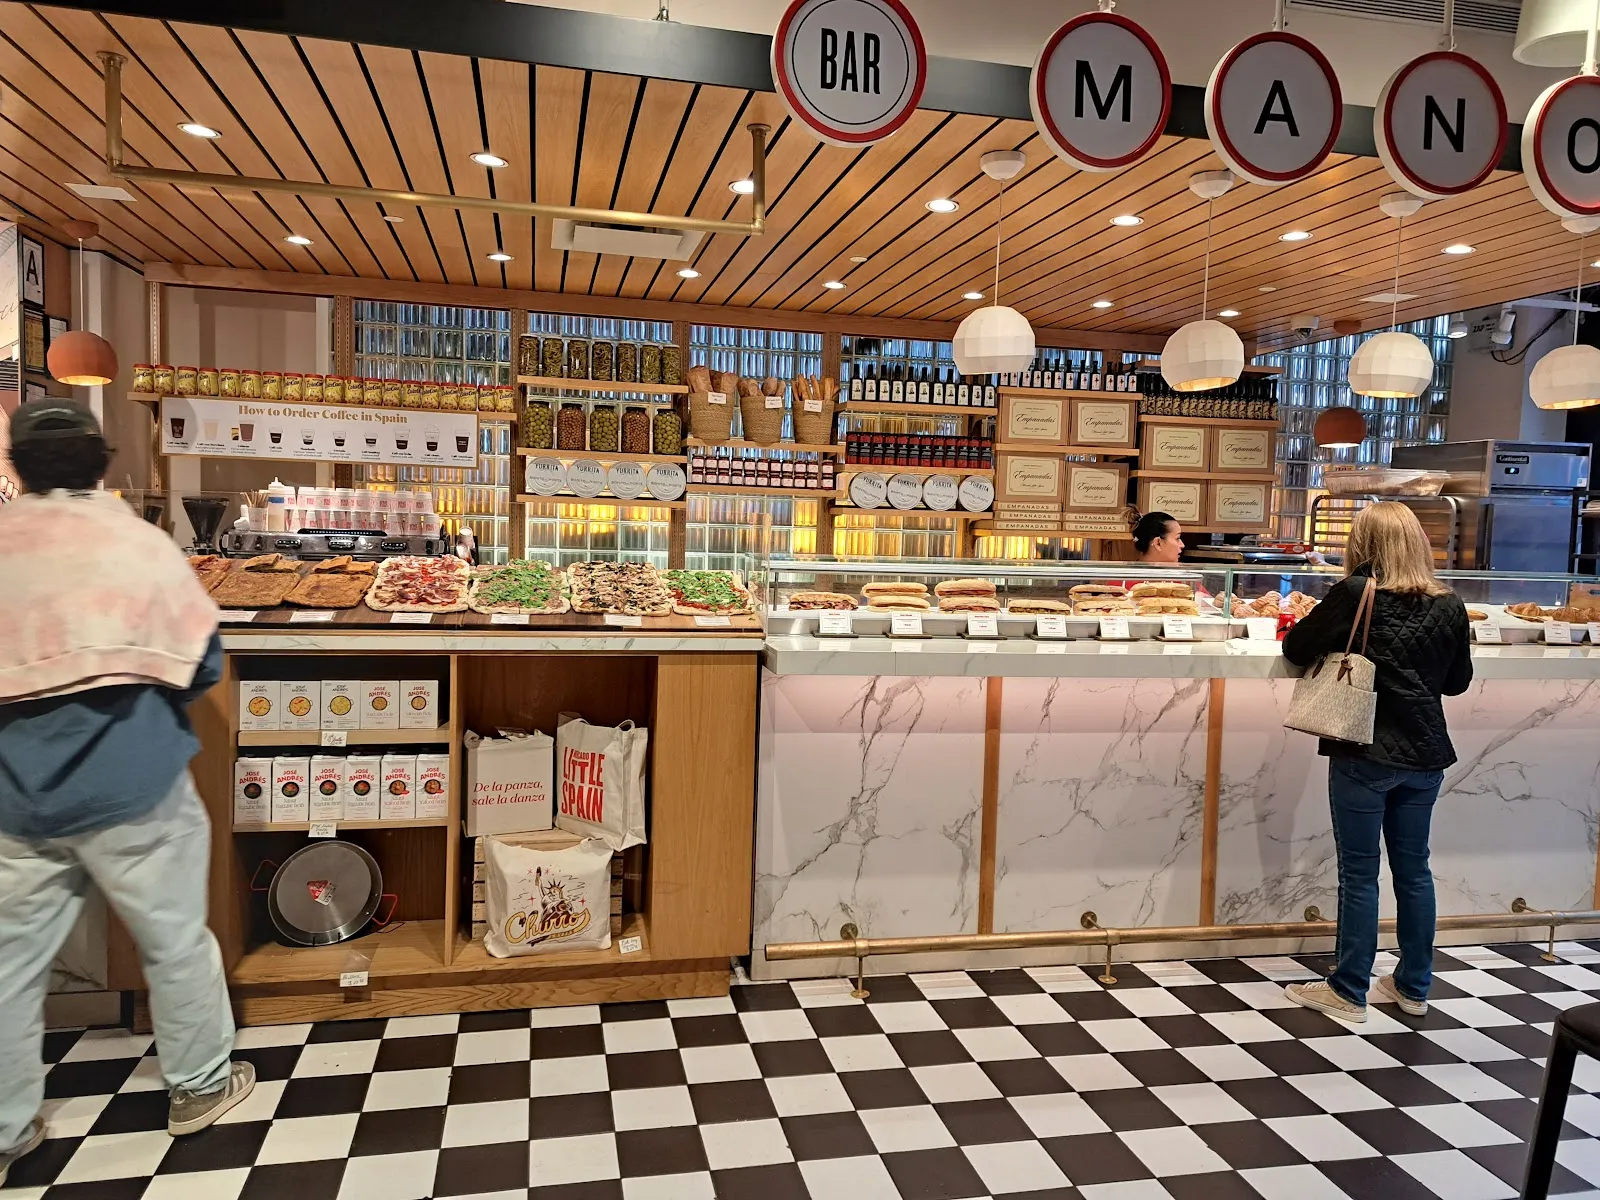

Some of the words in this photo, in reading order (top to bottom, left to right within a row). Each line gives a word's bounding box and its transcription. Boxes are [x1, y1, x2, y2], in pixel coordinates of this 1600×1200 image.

[820, 27, 881, 95] BAR
[1074, 60, 1133, 123] M
[1253, 79, 1300, 137] A
[1422, 95, 1466, 153] N
[1567, 117, 1600, 174] O
[238, 404, 266, 416] How
[268, 405, 281, 417] to
[282, 406, 320, 419] Order
[322, 409, 359, 421] Coffee
[361, 411, 373, 422] in
[374, 412, 408, 425] Spain
[1015, 413, 1056, 424] Empanadas
[1084, 417, 1123, 428] Empanadas
[1159, 441, 1199, 452] Empanadas
[1224, 443, 1264, 454] Empanadas
[1012, 470, 1053, 481] Empanadas
[1076, 482, 1113, 492] Empanadas
[1155, 495, 1195, 506] Empanadas
[1222, 498, 1259, 508] Empanadas
[283, 768, 297, 776] JOSÉ
[563, 746, 606, 787] LITTLE
[239, 774, 267, 785] ANDRÉS
[276, 773, 304, 783] ANDRÉS
[314, 772, 342, 782] ANDRÉS
[348, 772, 375, 782] ANDRÉS
[385, 771, 411, 781] ANDRÉS
[420, 770, 446, 781] ANDRÉS
[473, 782, 489, 793] De
[491, 781, 503, 792] la
[504, 780, 543, 795] panza,
[471, 794, 495, 806] sale
[497, 793, 508, 804] la
[509, 791, 546, 804] danza
[561, 780, 604, 824] SPAIN
